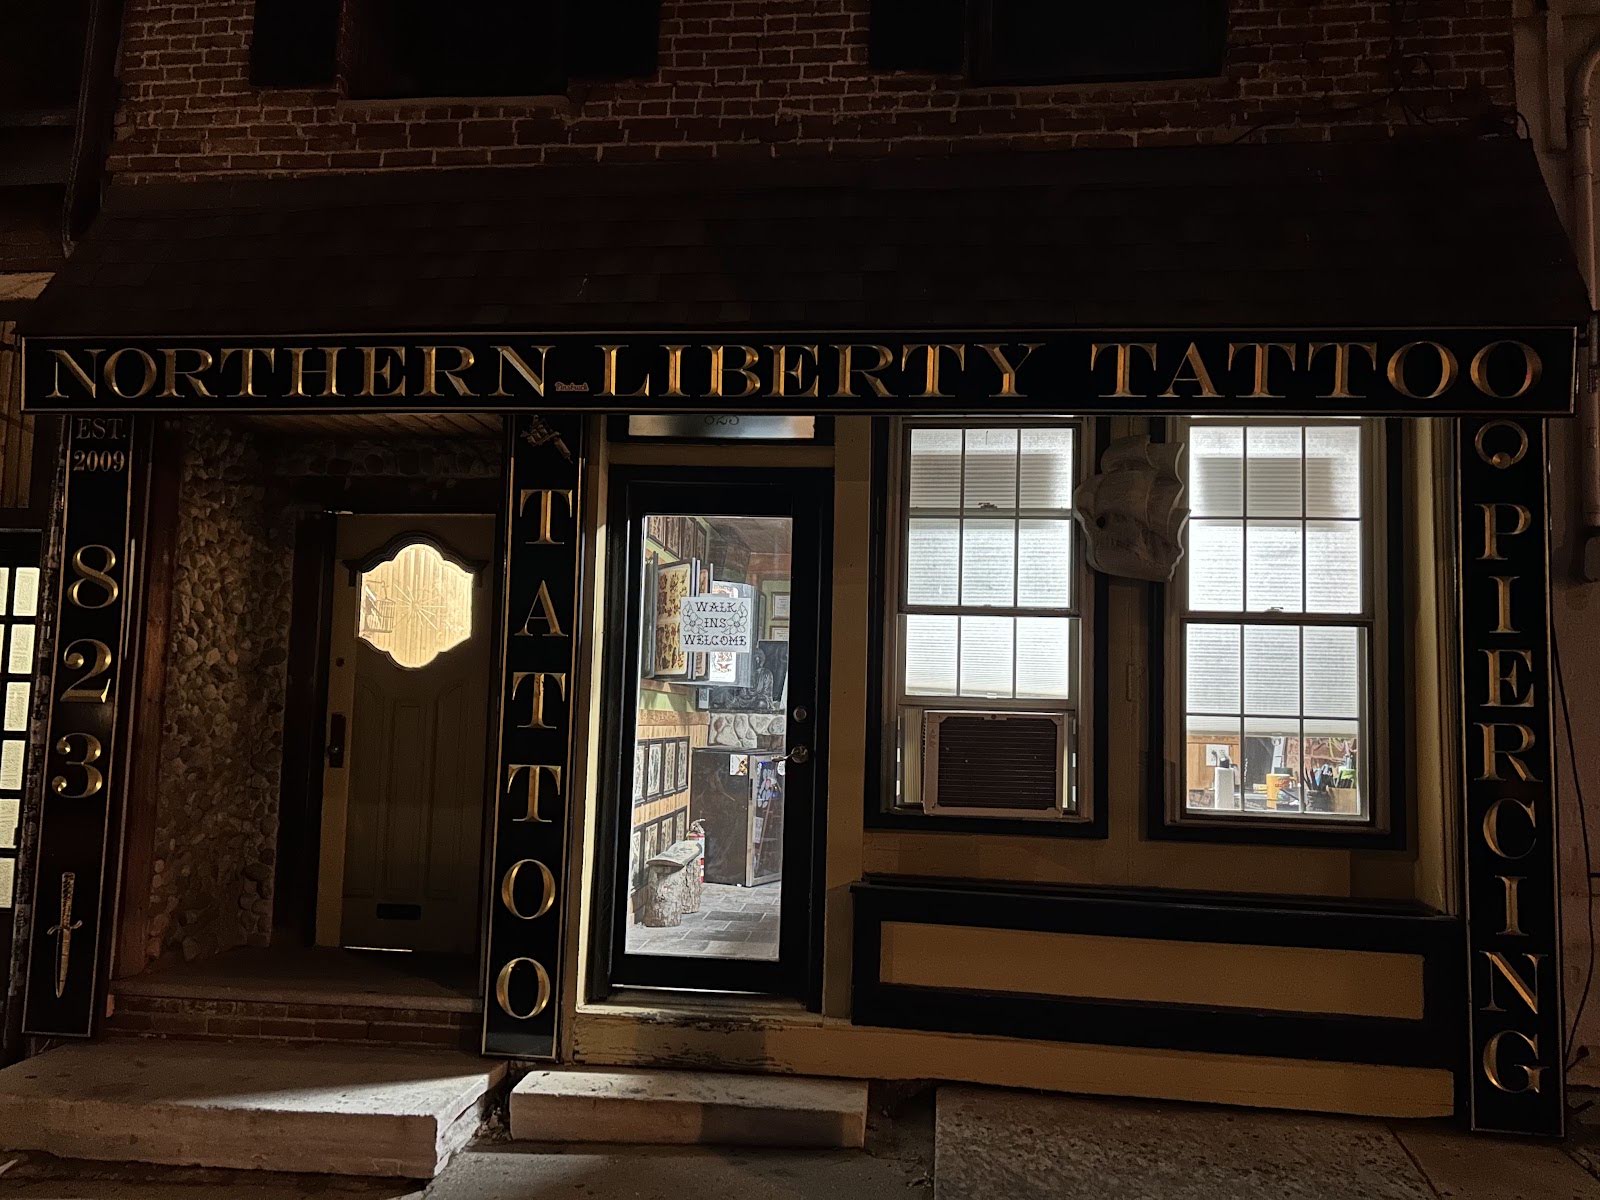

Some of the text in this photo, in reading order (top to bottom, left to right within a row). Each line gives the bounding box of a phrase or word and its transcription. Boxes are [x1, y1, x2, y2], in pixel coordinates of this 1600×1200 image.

[46, 341, 1543, 399] NORTHERN LIBERTY TATTOO
[75, 418, 126, 440] EST.
[73, 450, 125, 472] 2009
[695, 601, 738, 613] WALK
[704, 617, 727, 629] INS
[683, 634, 747, 647] WELCOME
[51, 544, 118, 798] 823
[496, 489, 573, 1019] TATTOO
[1473, 503, 1550, 1093] PIERCING
